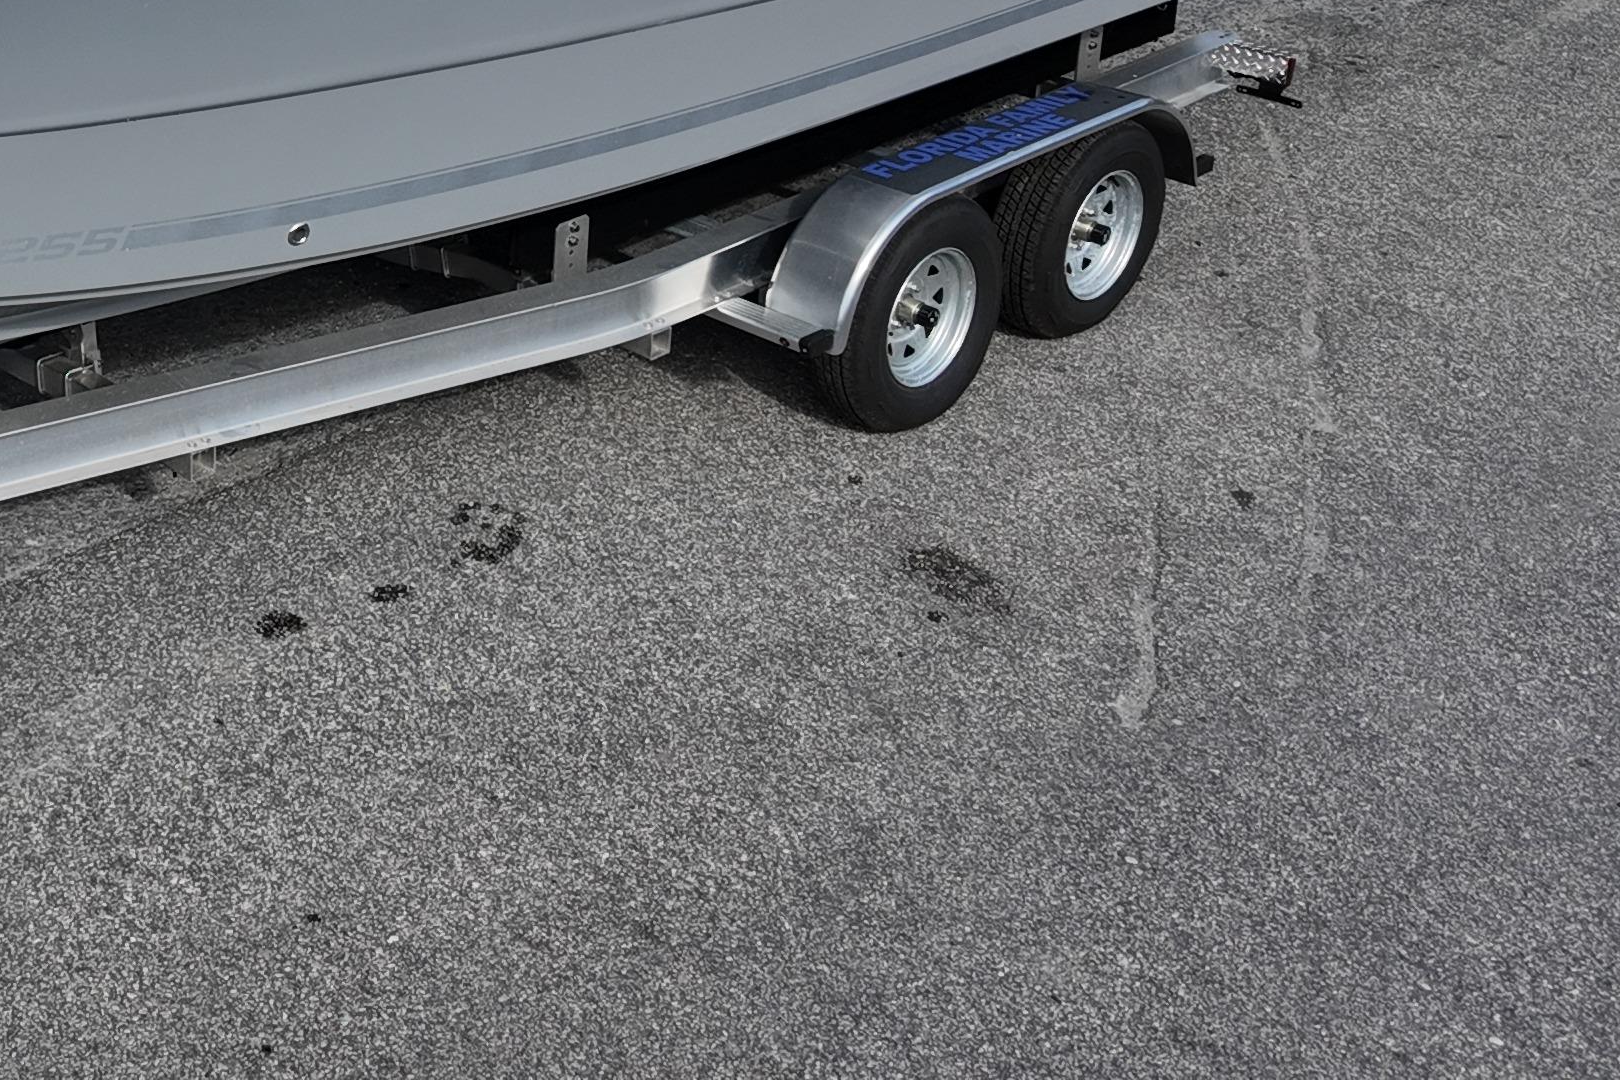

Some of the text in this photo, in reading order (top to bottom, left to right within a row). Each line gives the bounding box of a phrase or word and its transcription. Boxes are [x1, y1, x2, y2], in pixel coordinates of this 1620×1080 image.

[860, 85, 1094, 179] FLORIDA FAMILY
[953, 113, 1077, 162] MARINE
